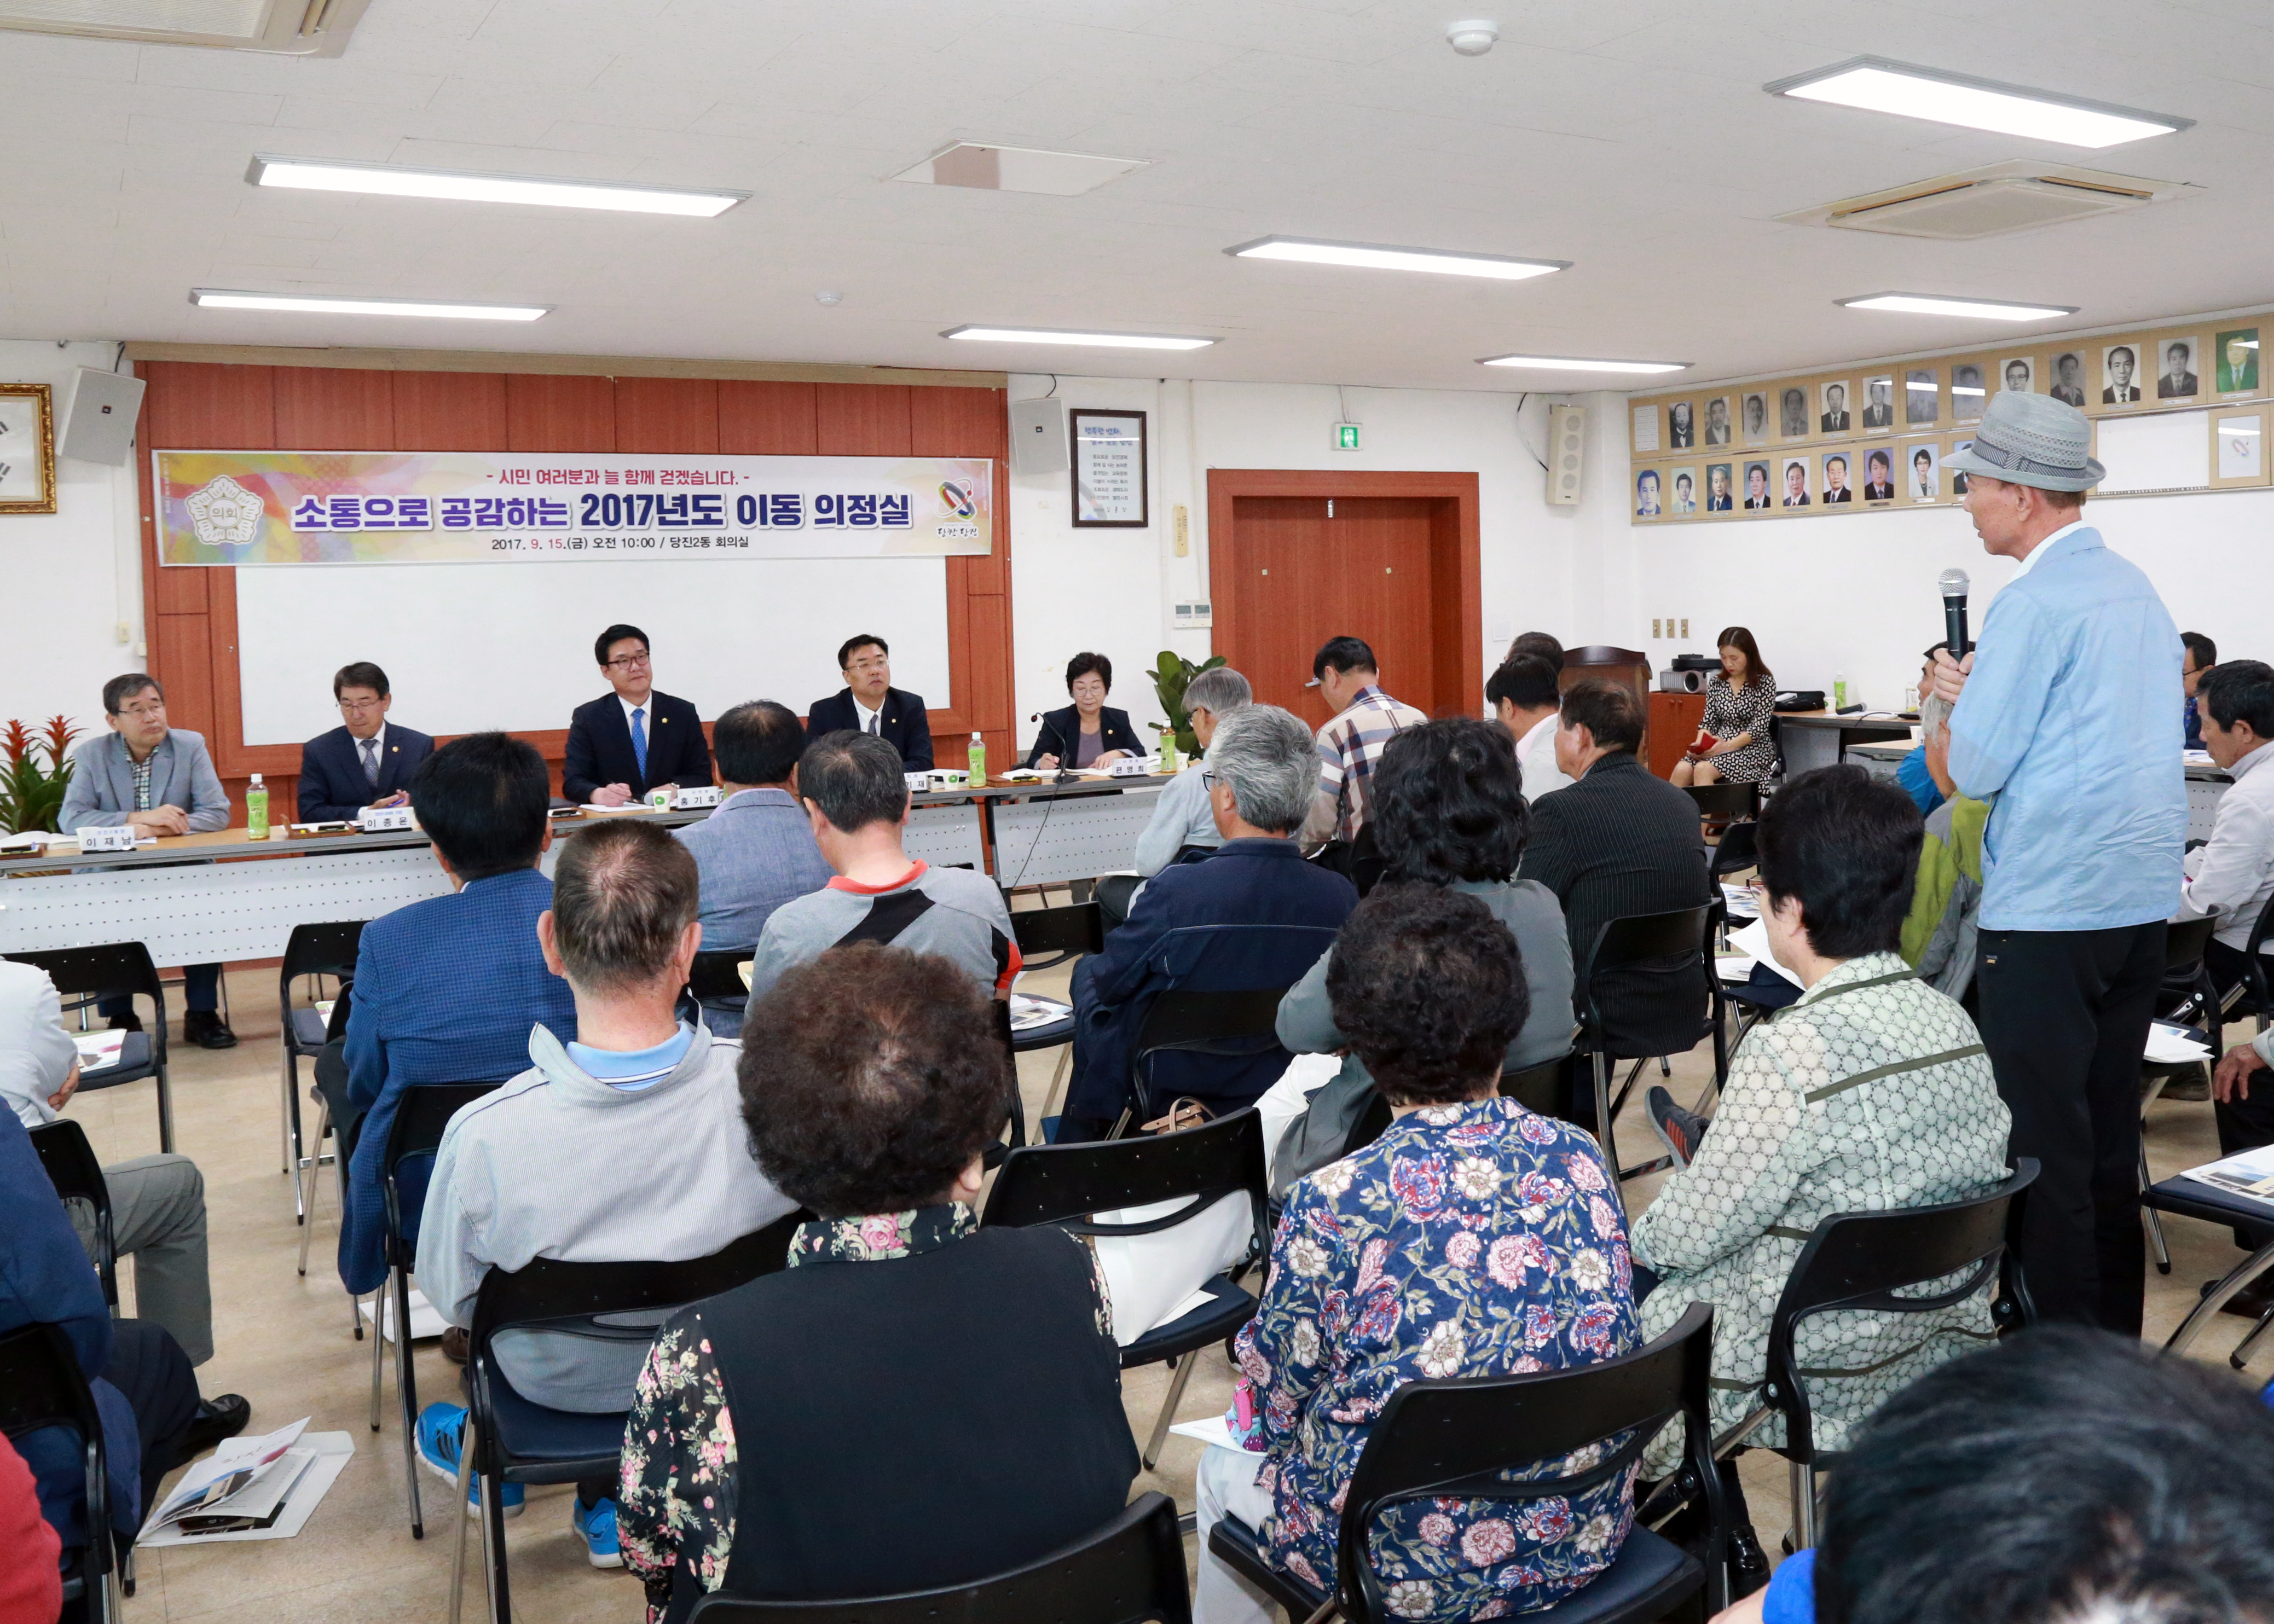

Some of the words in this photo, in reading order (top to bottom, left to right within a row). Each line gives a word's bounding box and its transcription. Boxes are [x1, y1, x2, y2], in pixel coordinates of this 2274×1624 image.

[499, 469, 530, 485] 시민
[536, 469, 600, 485] 여러분과
[605, 469, 619, 485] 늘
[624, 469, 655, 485] 함께
[660, 469, 738, 485] 걷겠습니다.
[212, 507, 238, 520] 의회
[294, 497, 432, 528] 소통으로
[441, 497, 570, 527] 공감하는
[581, 493, 725, 527] 2017년도
[737, 493, 802, 526] 이동
[815, 493, 911, 526] 의정실
[938, 527, 958, 537] 당찬
[959, 527, 977, 537] 당진
[492, 539, 525, 549] 2017.
[531, 538, 542, 549] 9.
[593, 537, 616, 549] 오전
[622, 537, 655, 548] 10:00
[670, 536, 711, 548] 당진2동
[715, 536, 749, 548] 회의실
